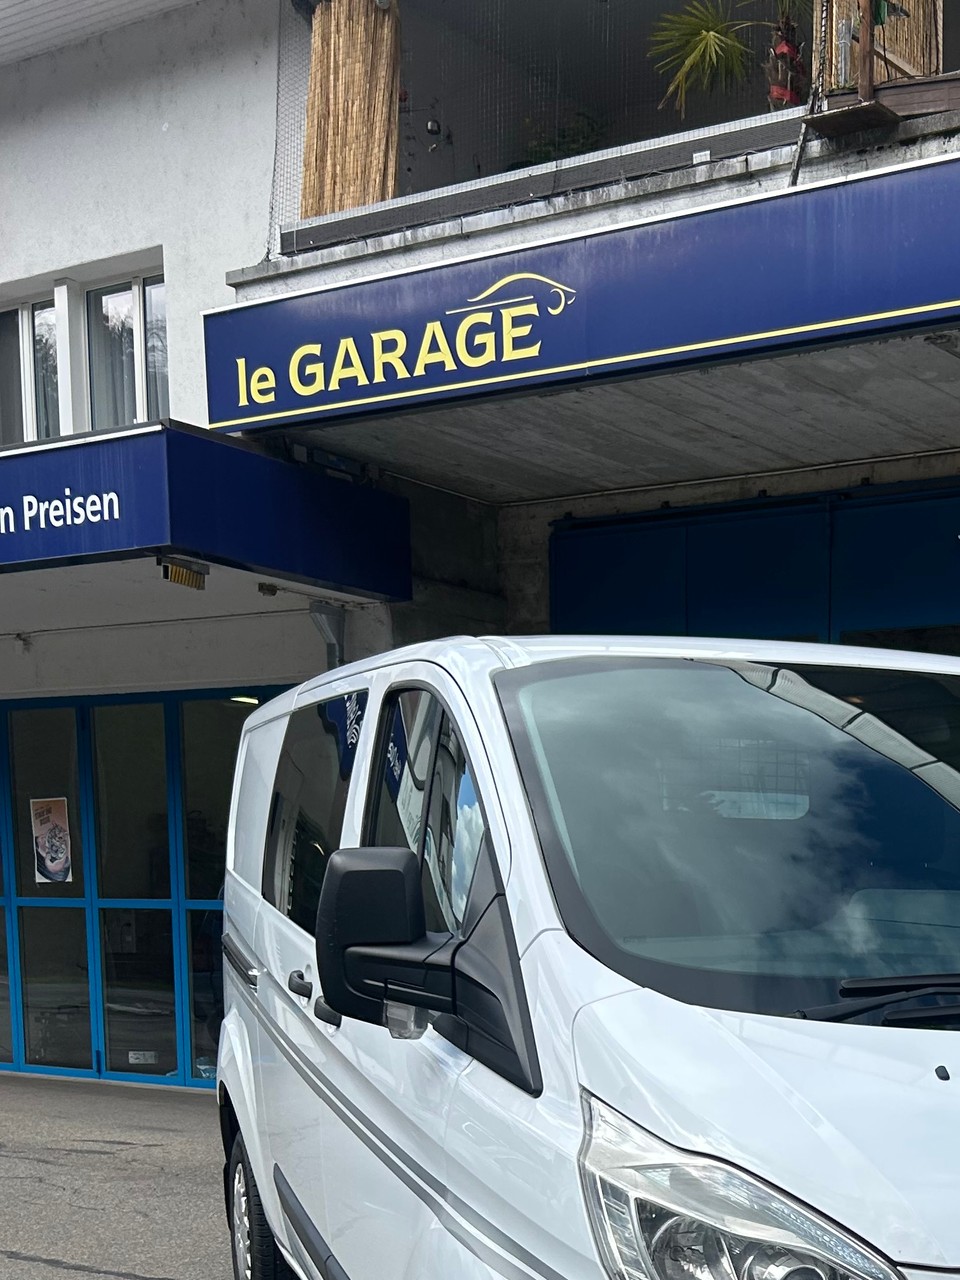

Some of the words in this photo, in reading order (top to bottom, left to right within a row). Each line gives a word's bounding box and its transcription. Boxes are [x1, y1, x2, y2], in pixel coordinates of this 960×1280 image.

[236, 357, 276, 407] le
[288, 303, 542, 397] GARAGE
[23, 487, 120, 531] Preisen
